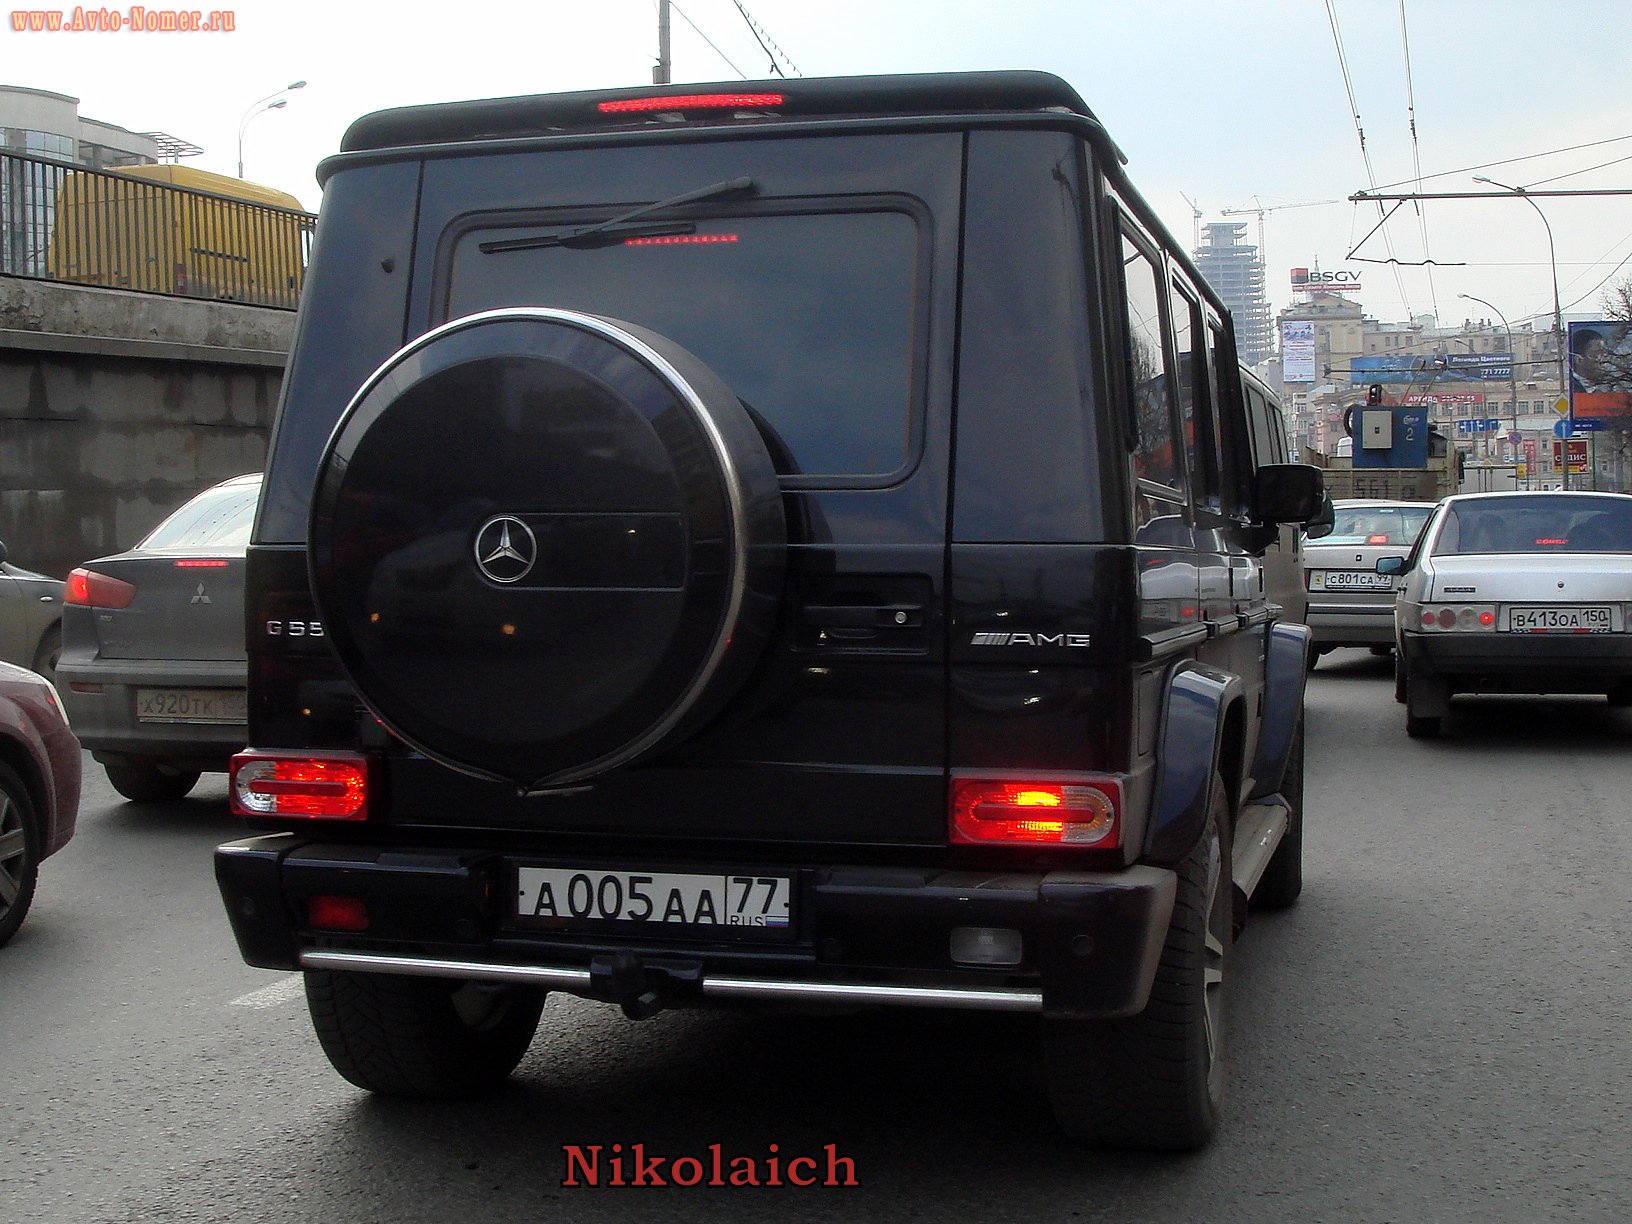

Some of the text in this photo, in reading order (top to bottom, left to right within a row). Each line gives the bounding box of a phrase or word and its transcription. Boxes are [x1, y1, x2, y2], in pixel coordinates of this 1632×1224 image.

[1309, 271, 1362, 282] BSGV
[1406, 427, 1414, 441] 2
[1555, 454, 1586, 462] СДИС
[1582, 610, 1606, 622] 150
[1007, 633, 1091, 648] AMG
[732, 877, 778, 914] 77
